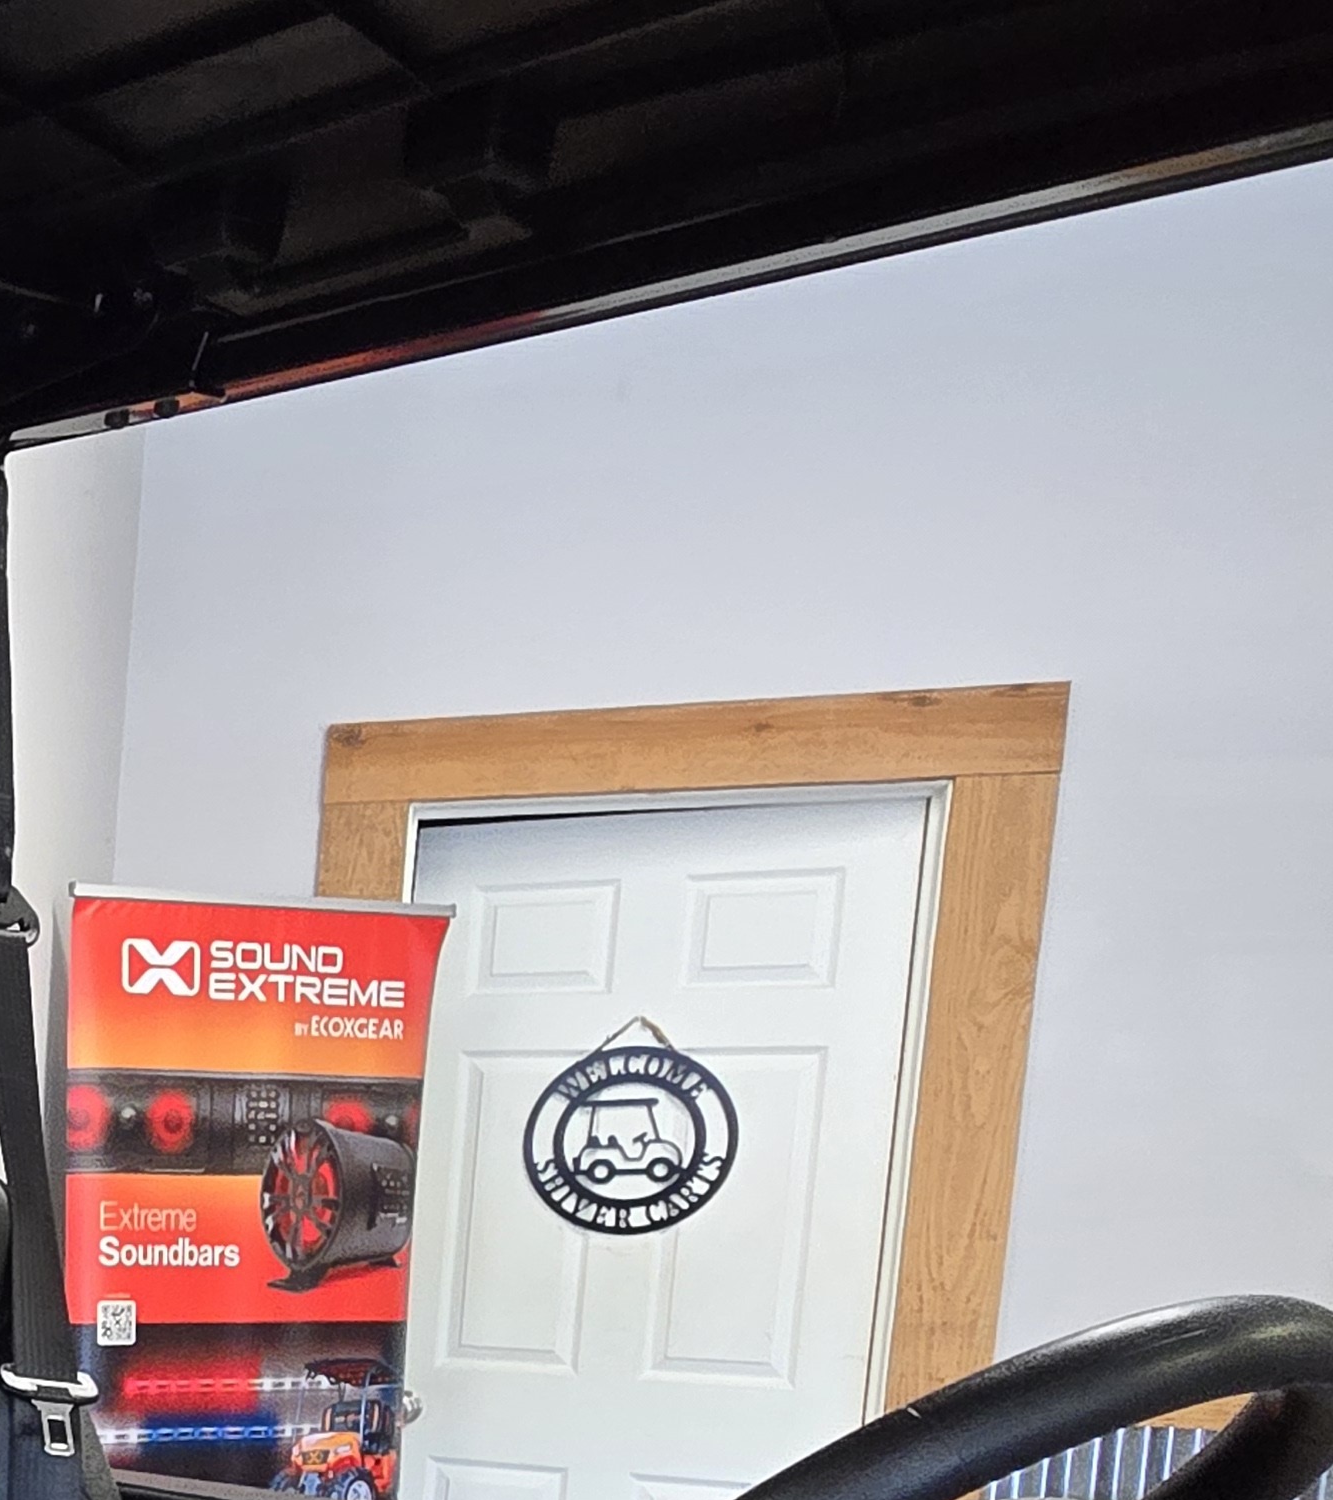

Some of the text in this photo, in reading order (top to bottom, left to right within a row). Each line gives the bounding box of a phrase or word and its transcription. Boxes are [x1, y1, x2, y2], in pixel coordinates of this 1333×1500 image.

[210, 941, 343, 974] SOUND
[208, 972, 405, 1008] EXTREME
[310, 1015, 404, 1040] ECOXGEAR
[555, 1053, 709, 1099] WELCOME
[647, 1153, 725, 1222] CARTS
[99, 1200, 197, 1233] Extreme
[98, 1236, 240, 1267] Soundbars
